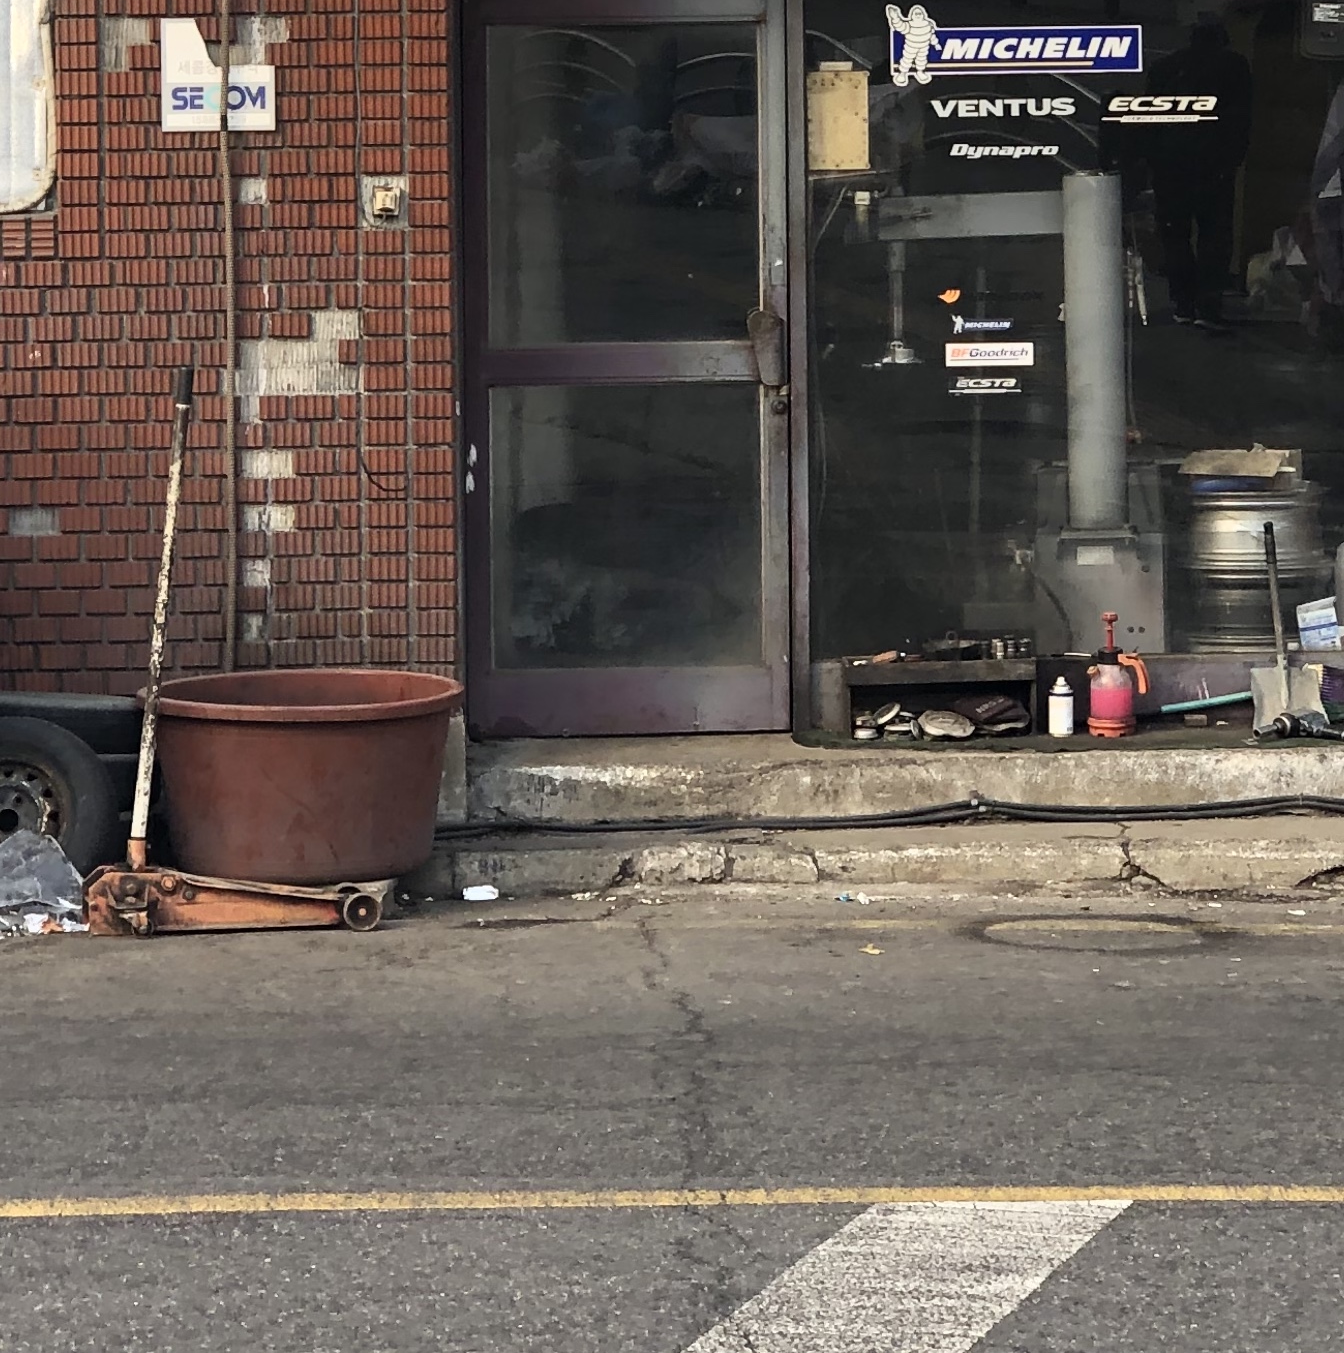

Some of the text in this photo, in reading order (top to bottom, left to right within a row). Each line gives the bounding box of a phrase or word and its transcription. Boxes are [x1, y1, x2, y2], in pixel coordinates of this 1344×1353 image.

[941, 36, 1132, 60] MICHELIN
[930, 97, 1076, 118] VENTUS
[950, 143, 1059, 158] Dynapro
[964, 321, 1012, 329] MICHELIN
[951, 347, 1029, 358] BFGoodrich
